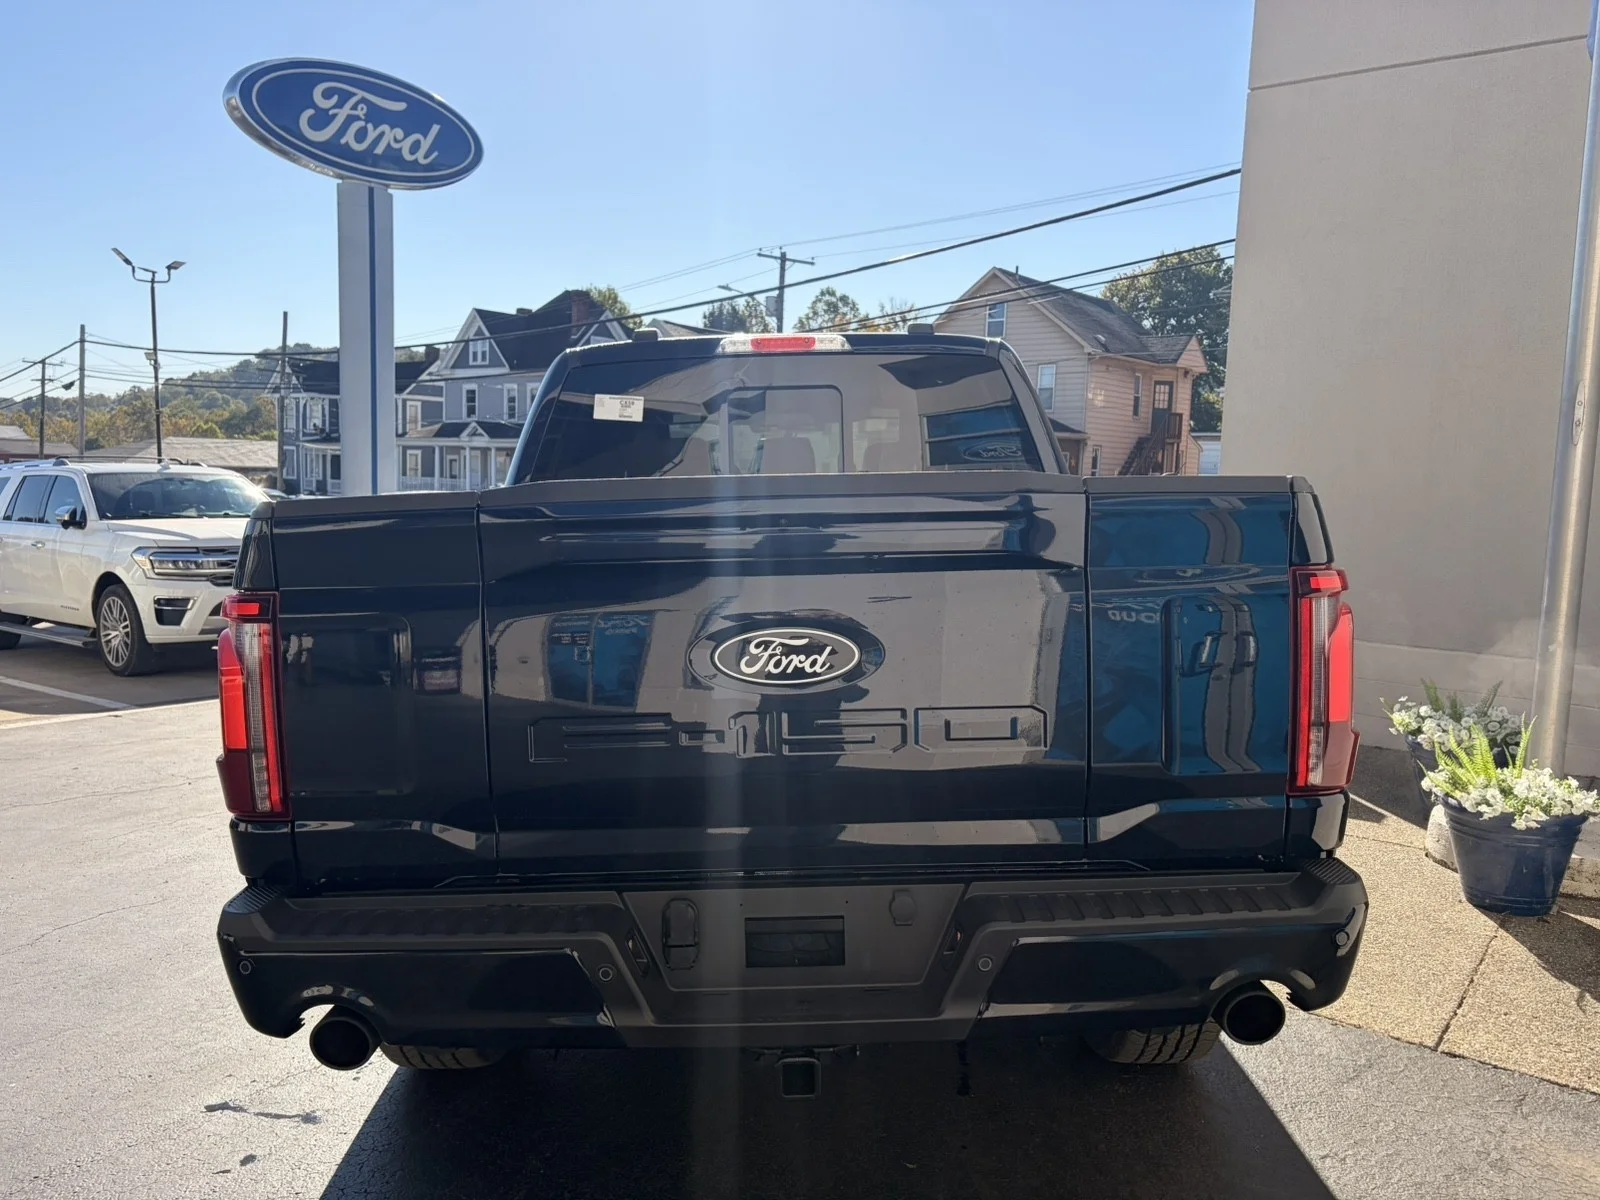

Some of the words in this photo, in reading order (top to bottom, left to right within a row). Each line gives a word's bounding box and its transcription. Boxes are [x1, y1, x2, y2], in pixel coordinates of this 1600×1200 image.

[299, 82, 441, 165] Ford
[740, 637, 833, 674] Ford
[528, 704, 1048, 764] F-150
